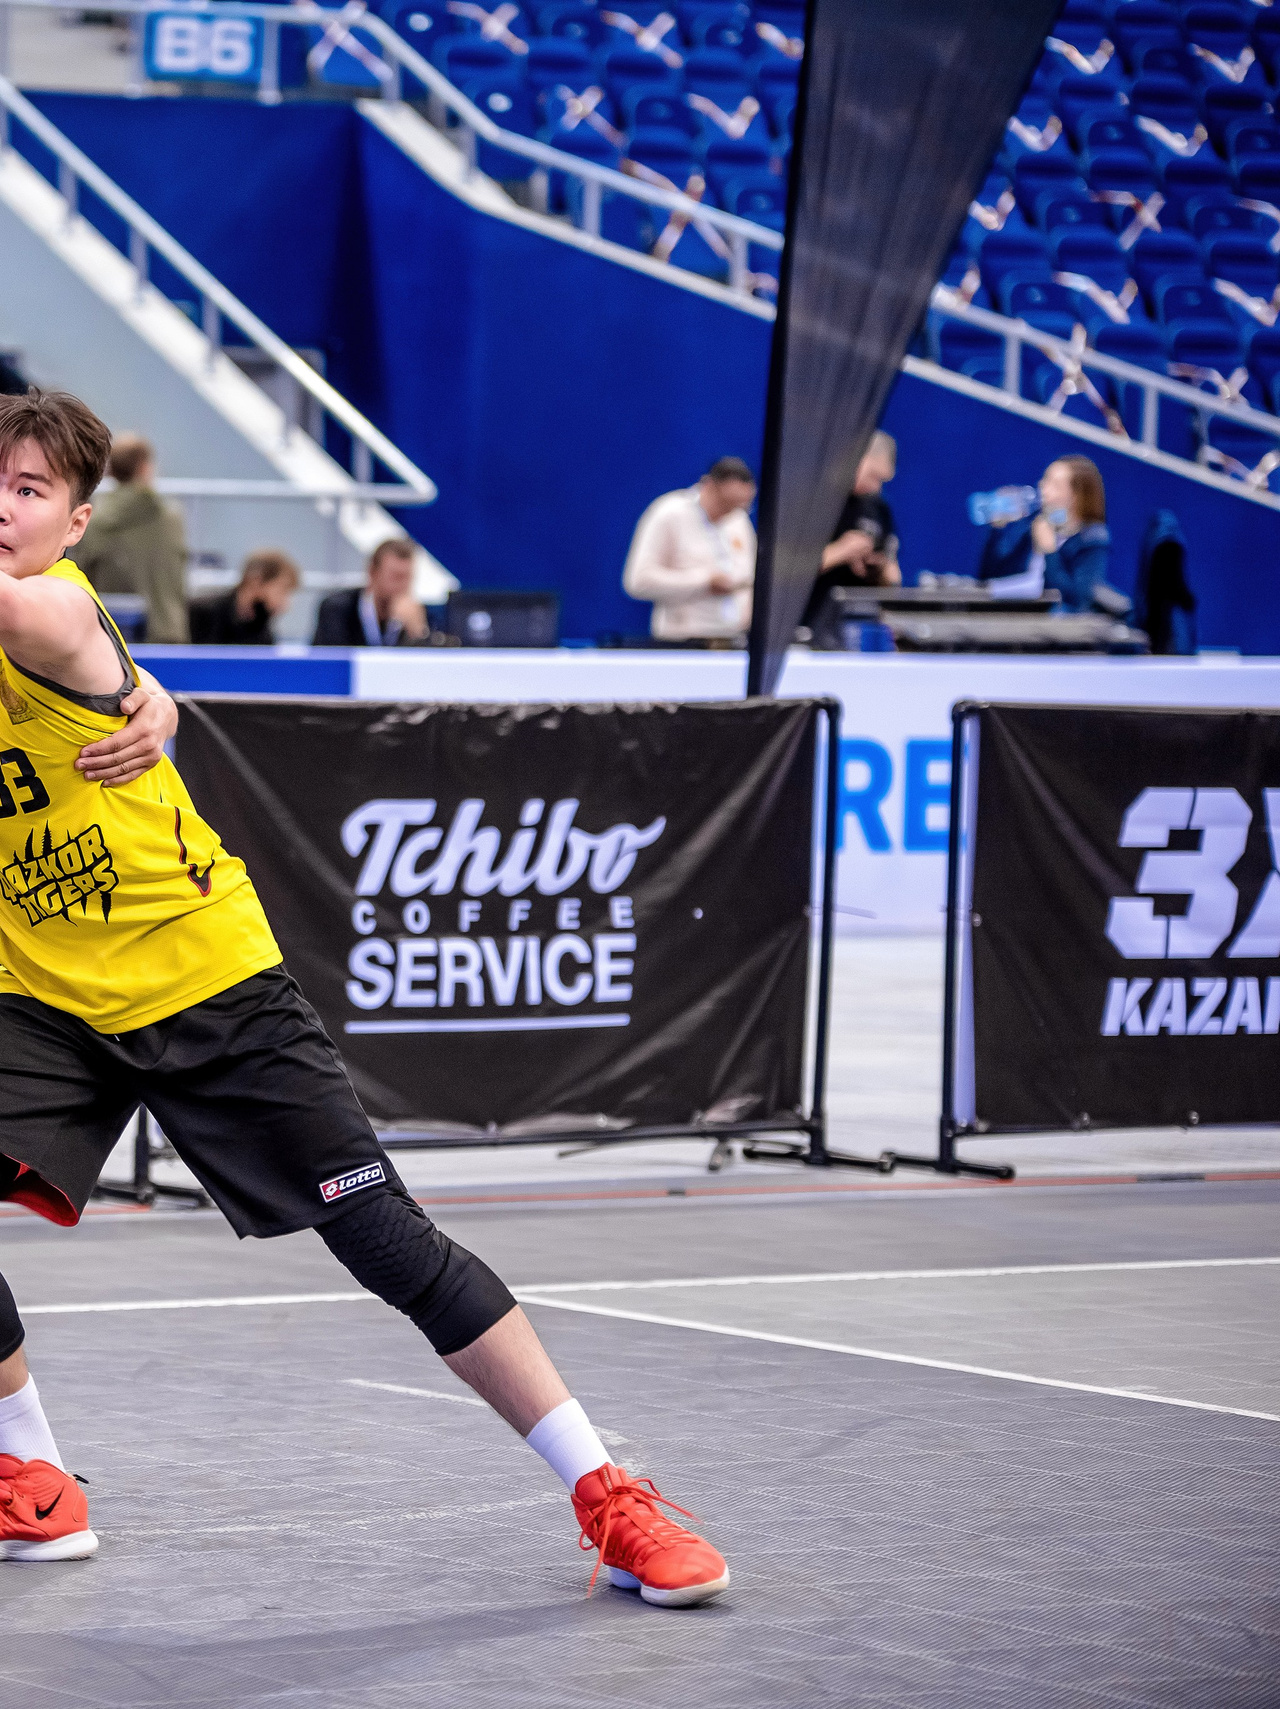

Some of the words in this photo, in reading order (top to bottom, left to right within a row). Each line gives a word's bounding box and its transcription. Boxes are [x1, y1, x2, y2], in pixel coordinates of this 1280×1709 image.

[154, 17, 254, 76] B6
[340, 798, 667, 897] Tchibo
[351, 896, 636, 935] COFFEE
[345, 932, 638, 1010] SERVICE
[338, 1168, 381, 1191] lotto
